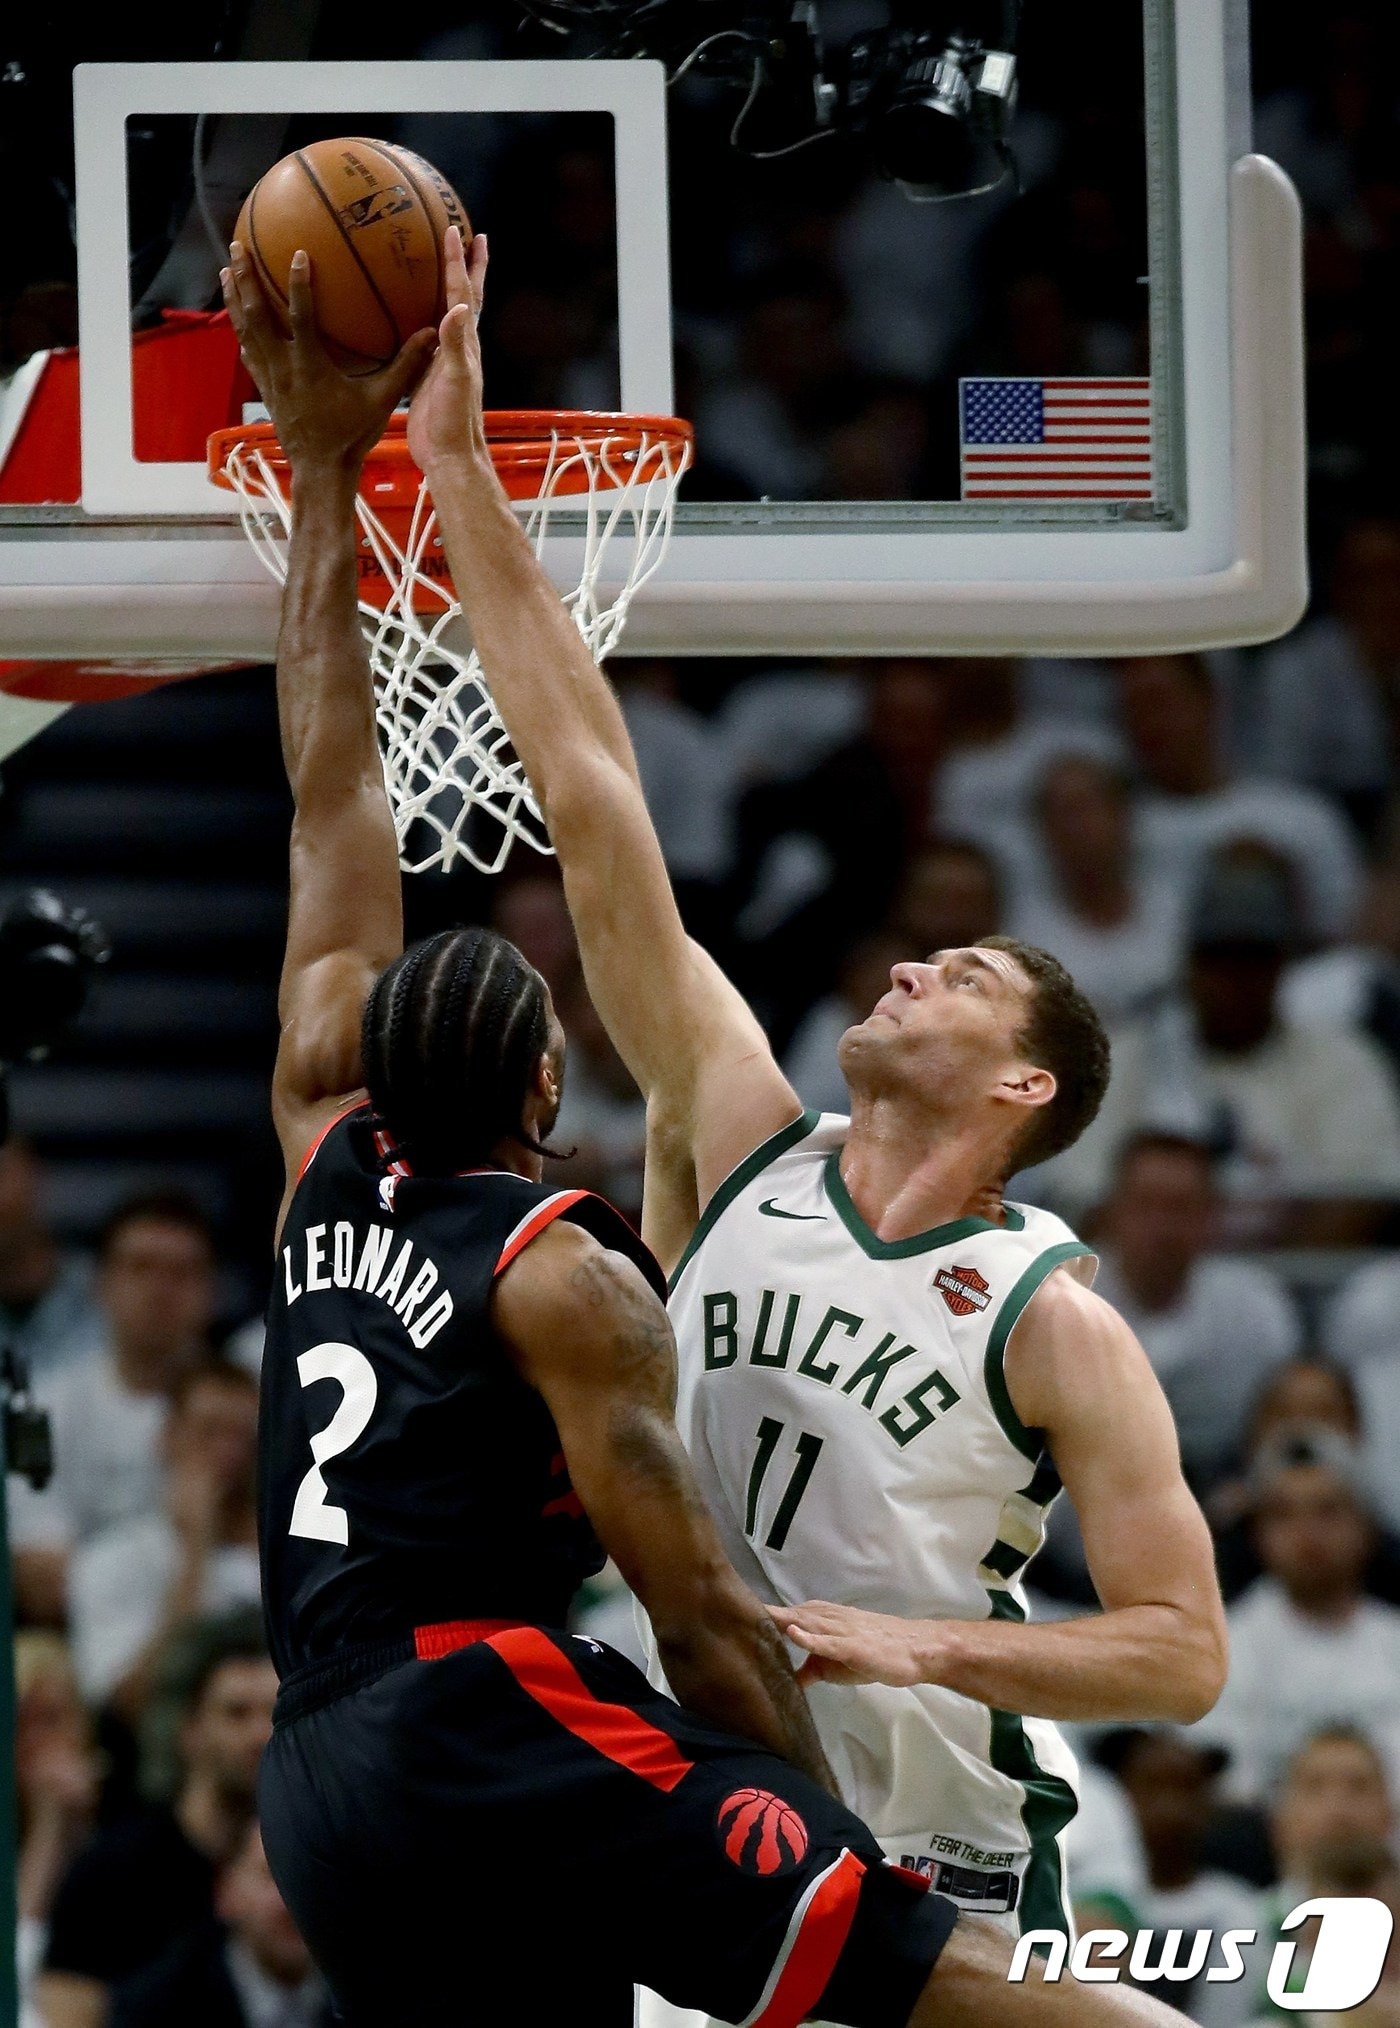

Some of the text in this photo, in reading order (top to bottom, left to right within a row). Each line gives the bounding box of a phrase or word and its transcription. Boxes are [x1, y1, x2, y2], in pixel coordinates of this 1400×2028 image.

[283, 1221, 454, 1350] LEONARD
[703, 1289, 962, 1449] BUCKS
[288, 1342, 378, 1546] 2
[744, 1416, 825, 1551] 11
[929, 1833, 1015, 1868] FEAR THE DEER
